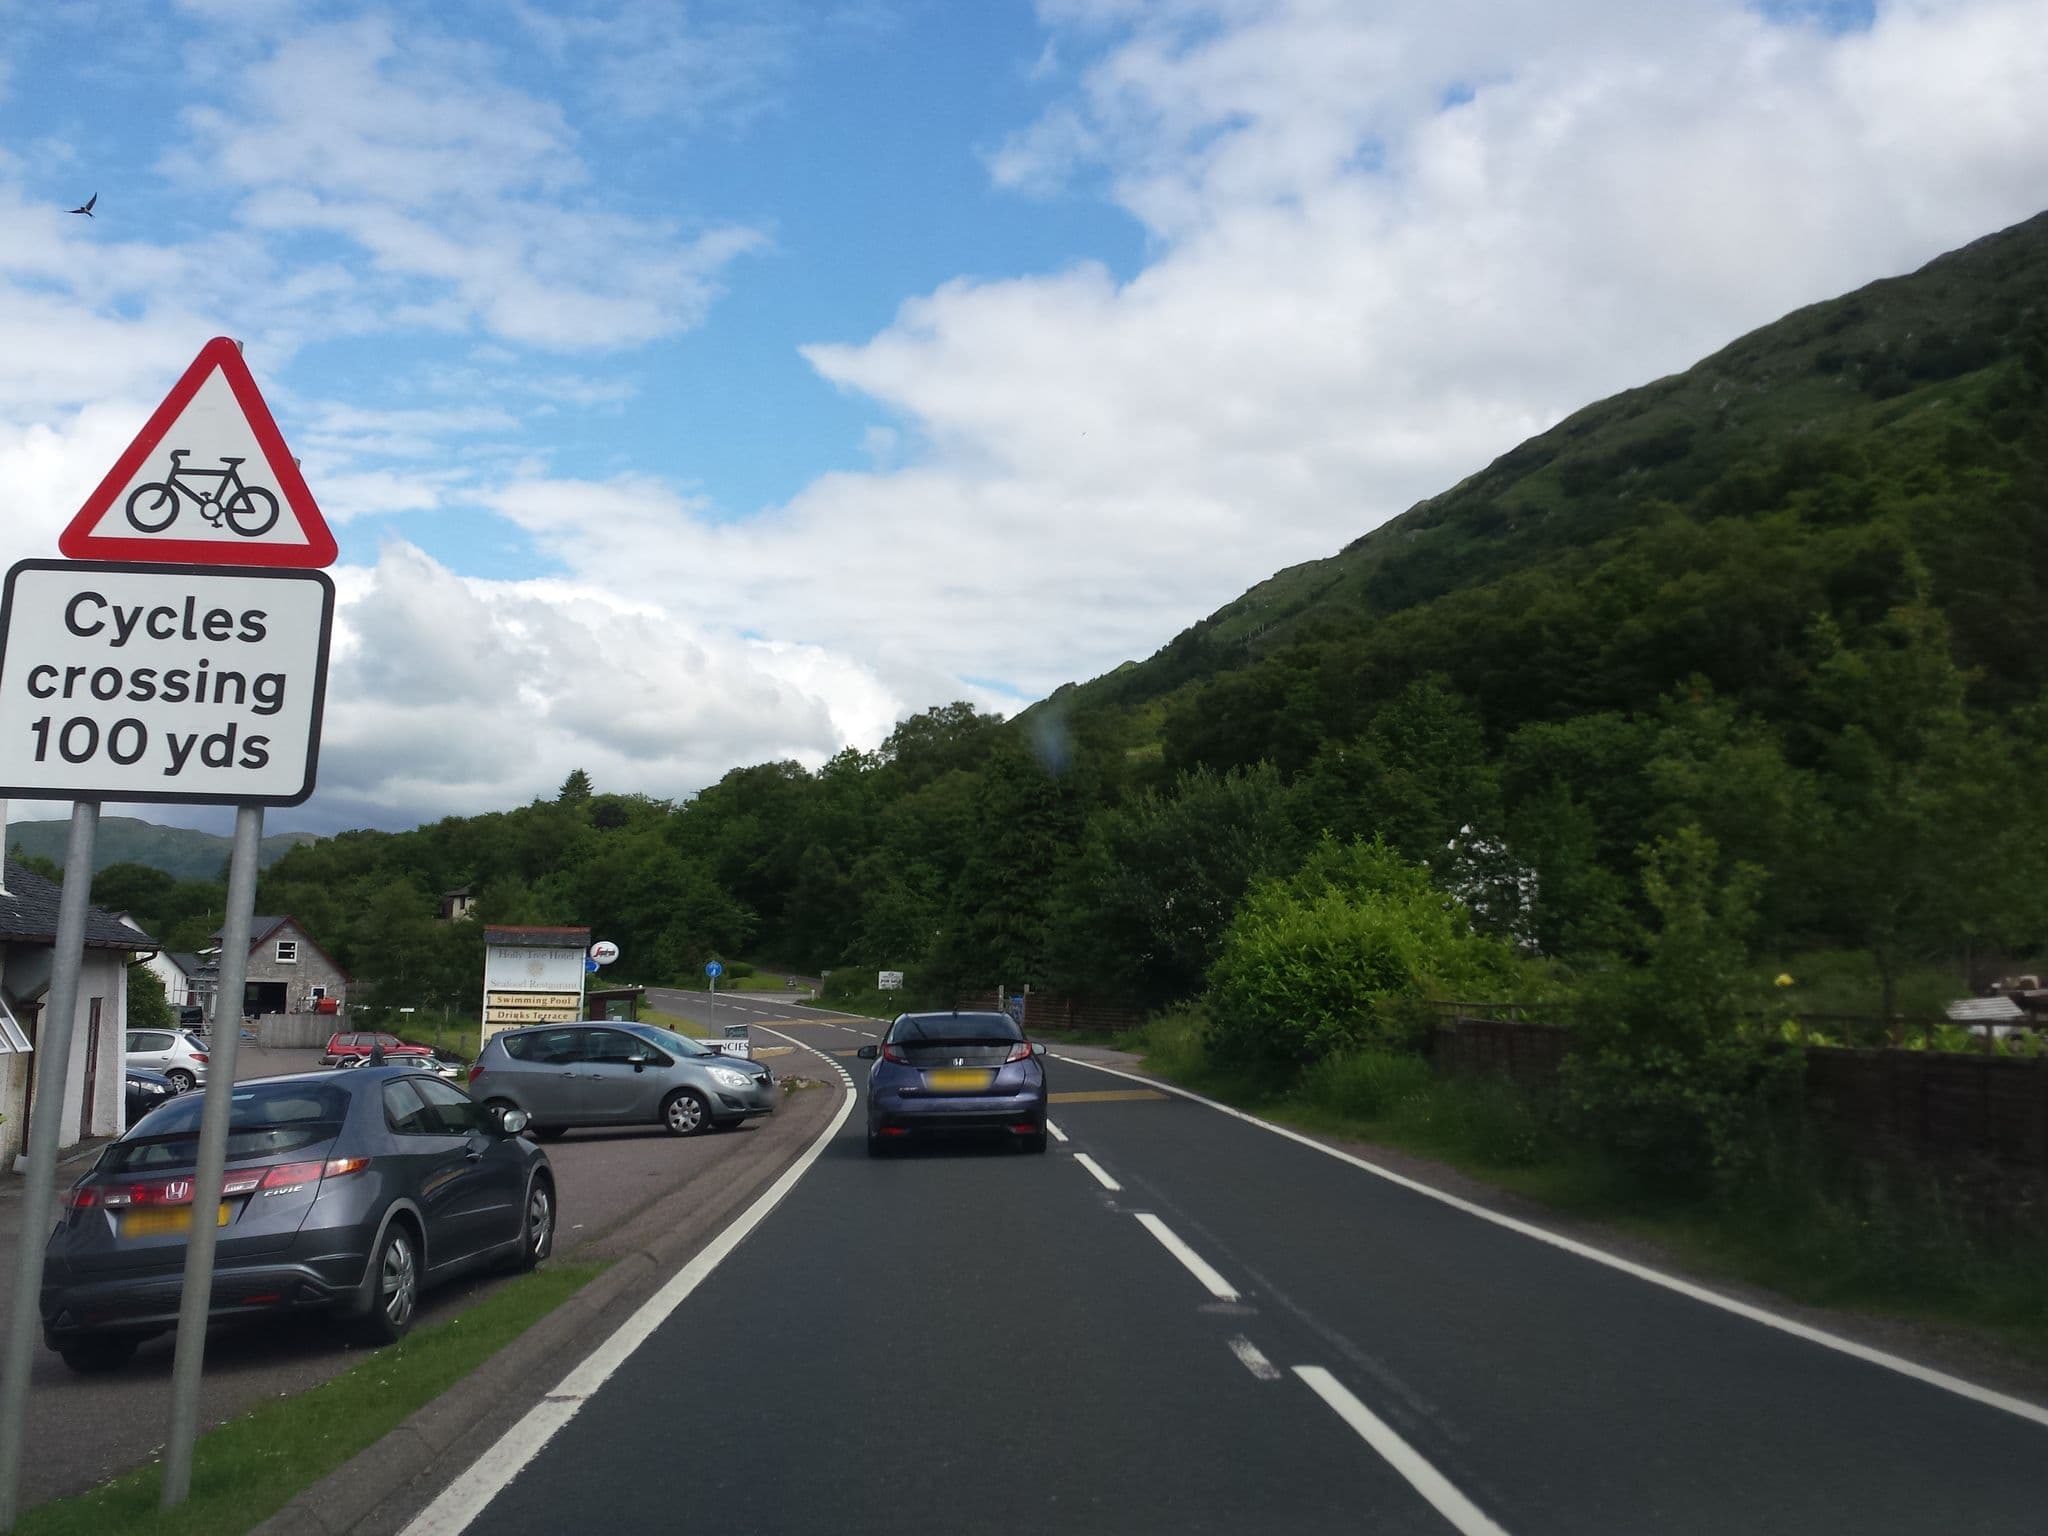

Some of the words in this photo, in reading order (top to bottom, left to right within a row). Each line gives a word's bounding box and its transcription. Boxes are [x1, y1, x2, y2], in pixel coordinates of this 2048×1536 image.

[64, 591, 268, 648] Cycles
[27, 658, 287, 716] crossing
[31, 716, 148, 766] 100
[163, 722, 271, 777] yds
[497, 996, 548, 1006] Swimming
[550, 997, 571, 1005] Pool
[498, 1011, 530, 1020] Drinks
[533, 1012, 568, 1020] Terrace
